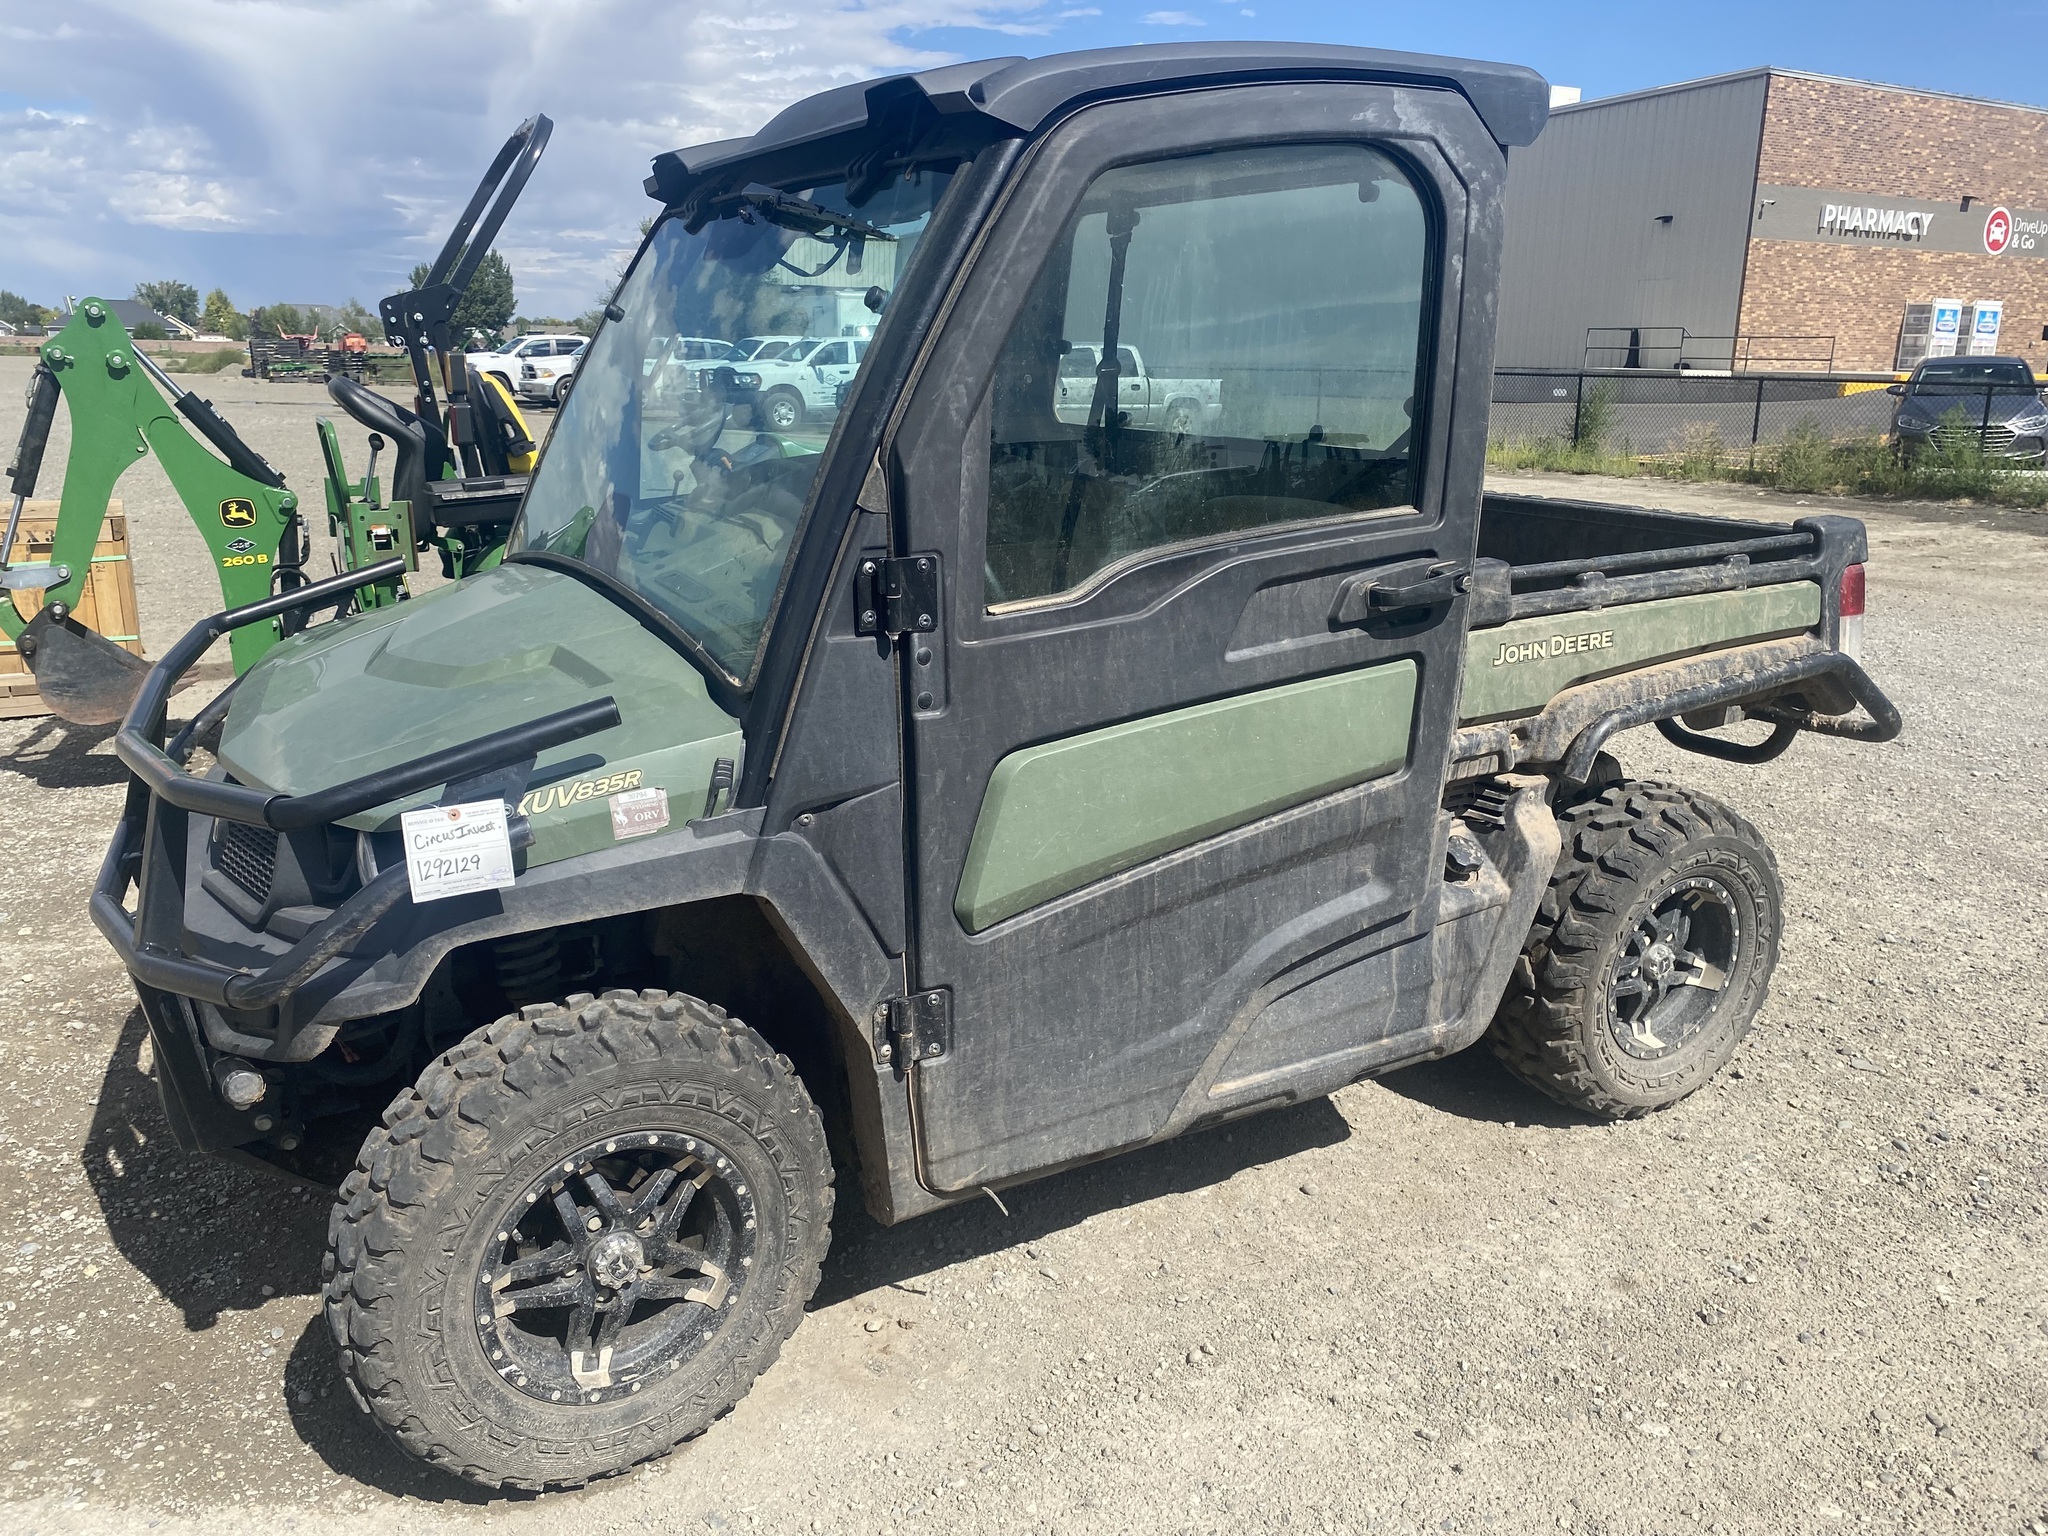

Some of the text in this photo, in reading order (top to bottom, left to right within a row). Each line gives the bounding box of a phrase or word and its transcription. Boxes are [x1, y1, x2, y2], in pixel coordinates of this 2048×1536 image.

[1820, 204, 1935, 236] PHARMACY
[2013, 217, 2048, 237] DriveUp
[2011, 233, 2035, 250] & Go
[222, 553, 269, 567] 260 B
[1493, 630, 1614, 667] JOHN DEERE
[407, 819, 428, 827] SERVICE
[634, 809, 660, 822] ORV
[417, 854, 481, 881] 1292129
[562, 1122, 606, 1149] KING
